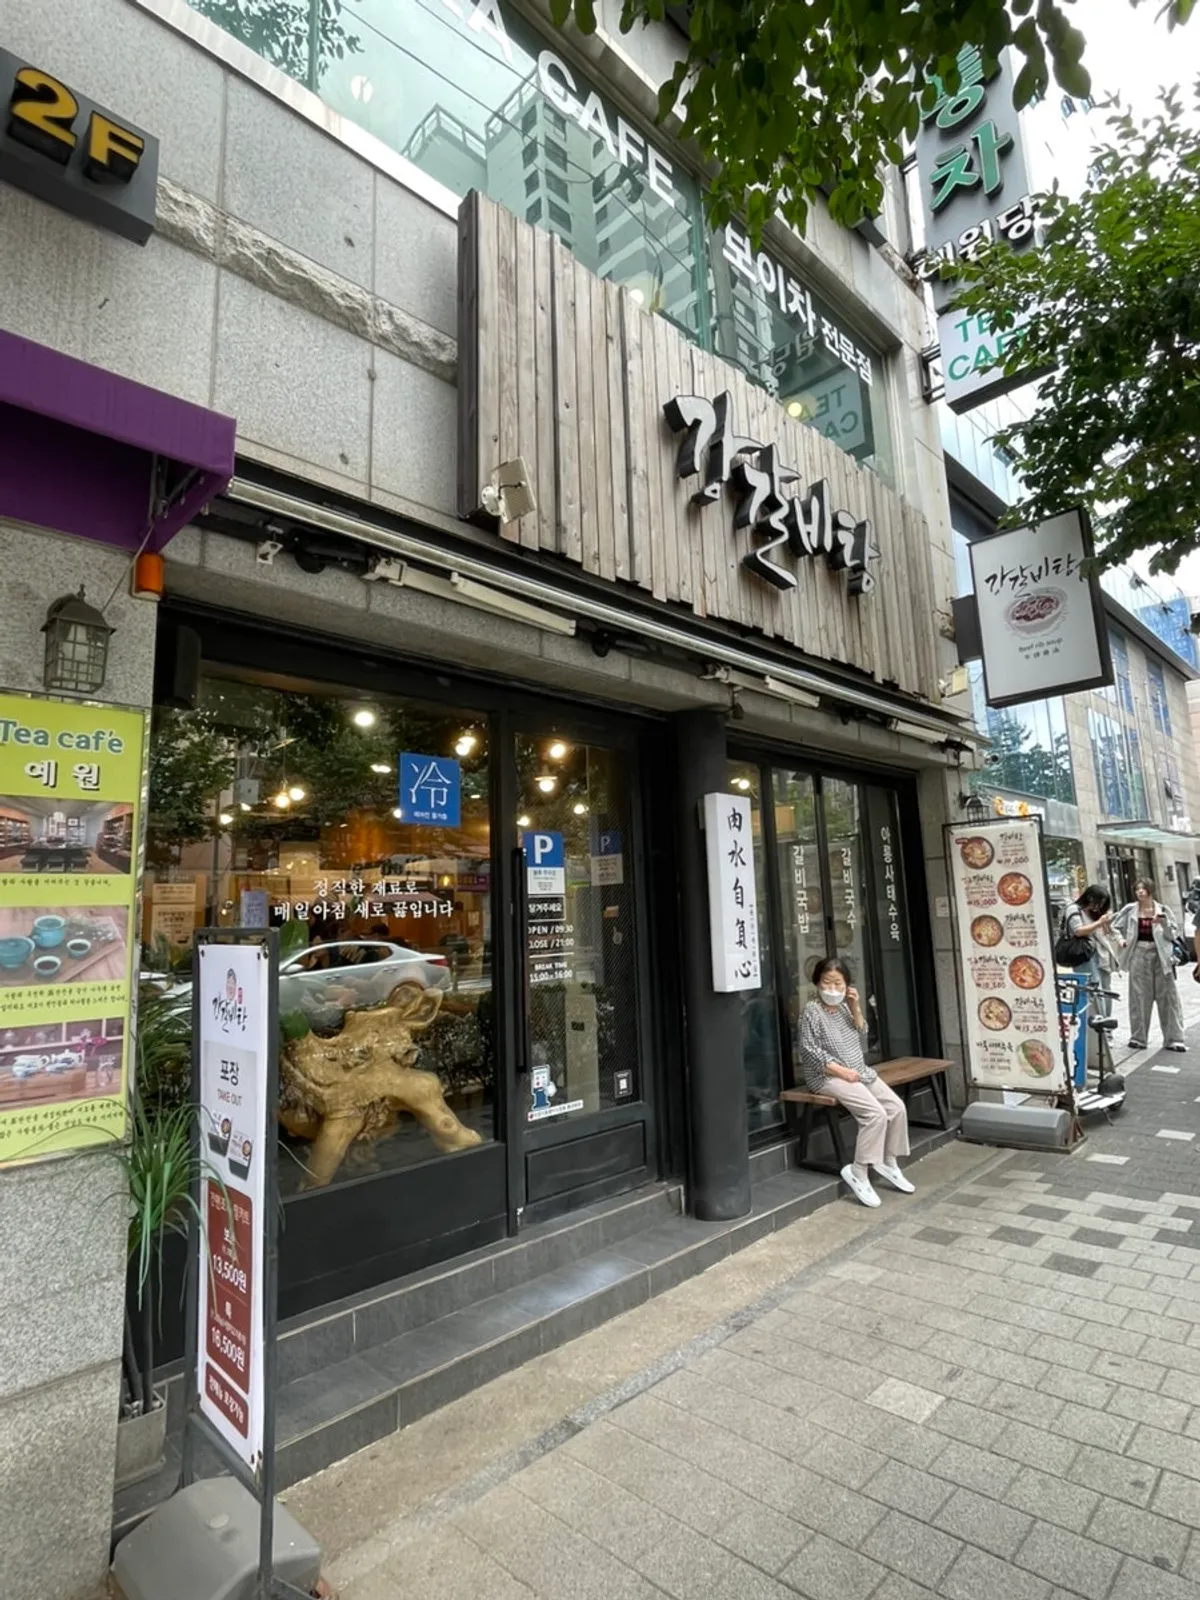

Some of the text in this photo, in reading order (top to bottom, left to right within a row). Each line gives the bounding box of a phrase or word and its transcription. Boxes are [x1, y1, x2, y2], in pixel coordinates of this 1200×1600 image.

[10, 67, 145, 172] 2F
[537, 50, 675, 208] CAFE
[722, 220, 874, 387] 보이차 전문점
[954, 310, 1013, 342] TE
[664, 389, 881, 594] 강갈비탕
[0, 719, 50, 747] Tea
[408, 761, 453, 809] 冷
[534, 834, 553, 865] P
[313, 878, 420, 897] 정직한 재료로
[792, 845, 810, 934] 갈비국밥
[841, 847, 857, 930] 갈비국수
[354, 900, 387, 919] 새로
[392, 899, 454, 919] 끓입니다
[534, 961, 568, 971] BREAK TIME
[219, 1059, 240, 1086] 포장
[217, 1088, 243, 1107] TAKE OUT
[213, 1254, 247, 1295] 13,500원
